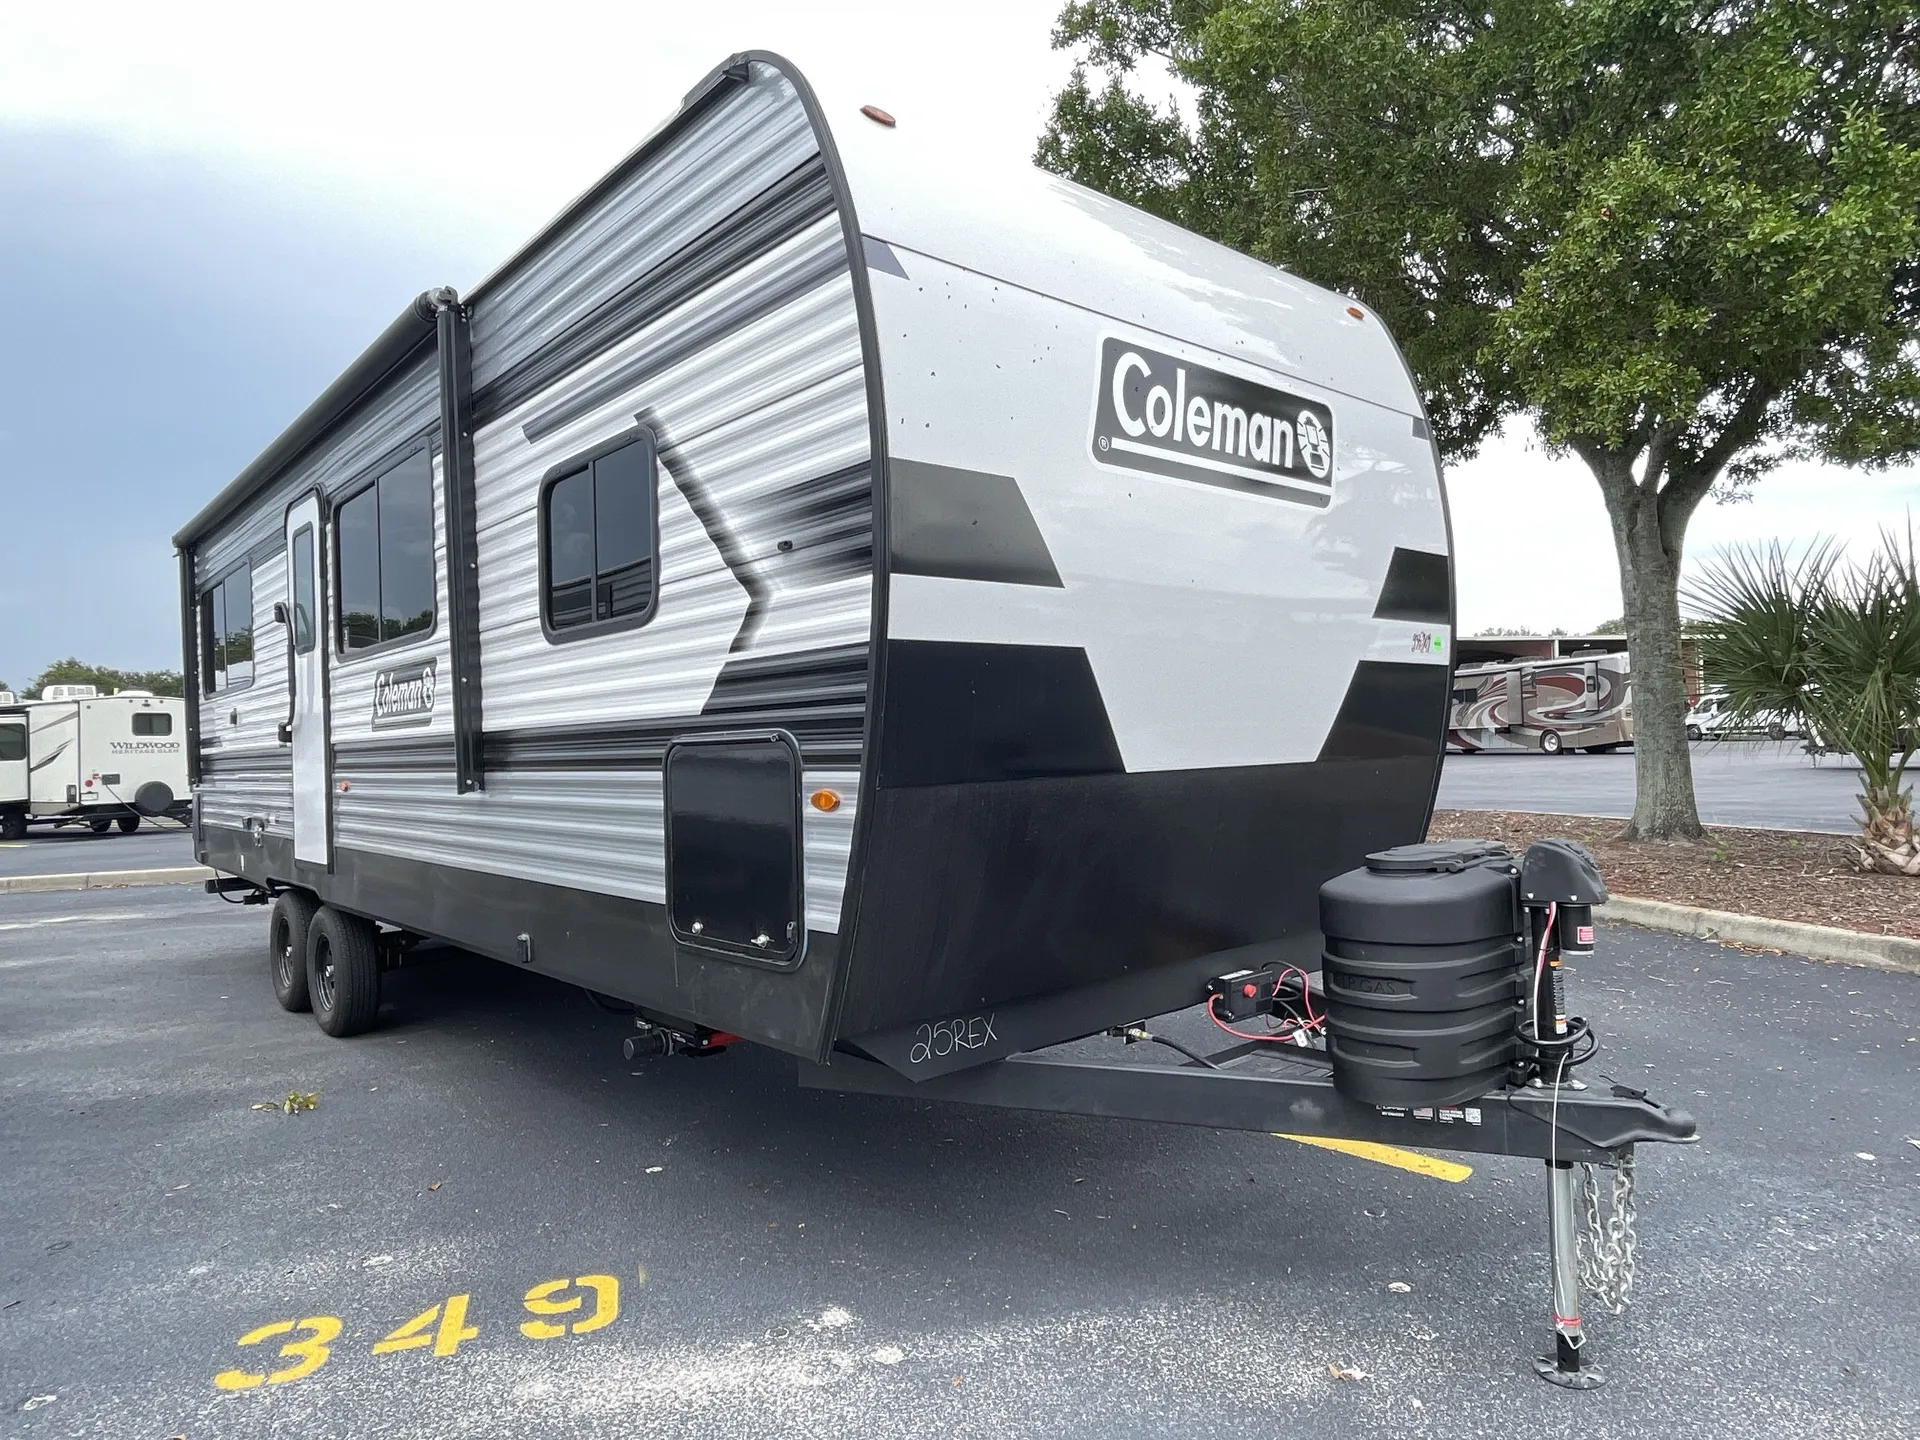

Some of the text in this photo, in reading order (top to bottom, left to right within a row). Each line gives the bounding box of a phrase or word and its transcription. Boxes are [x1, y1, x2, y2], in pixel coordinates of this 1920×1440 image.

[1112, 351, 1294, 469] Coleman
[375, 672, 422, 717] Coleman
[109, 741, 181, 750] WILDWOOD
[1360, 979, 1396, 995] GAS
[910, 1012, 998, 1064] 25REX
[213, 1273, 620, 1391] 349
